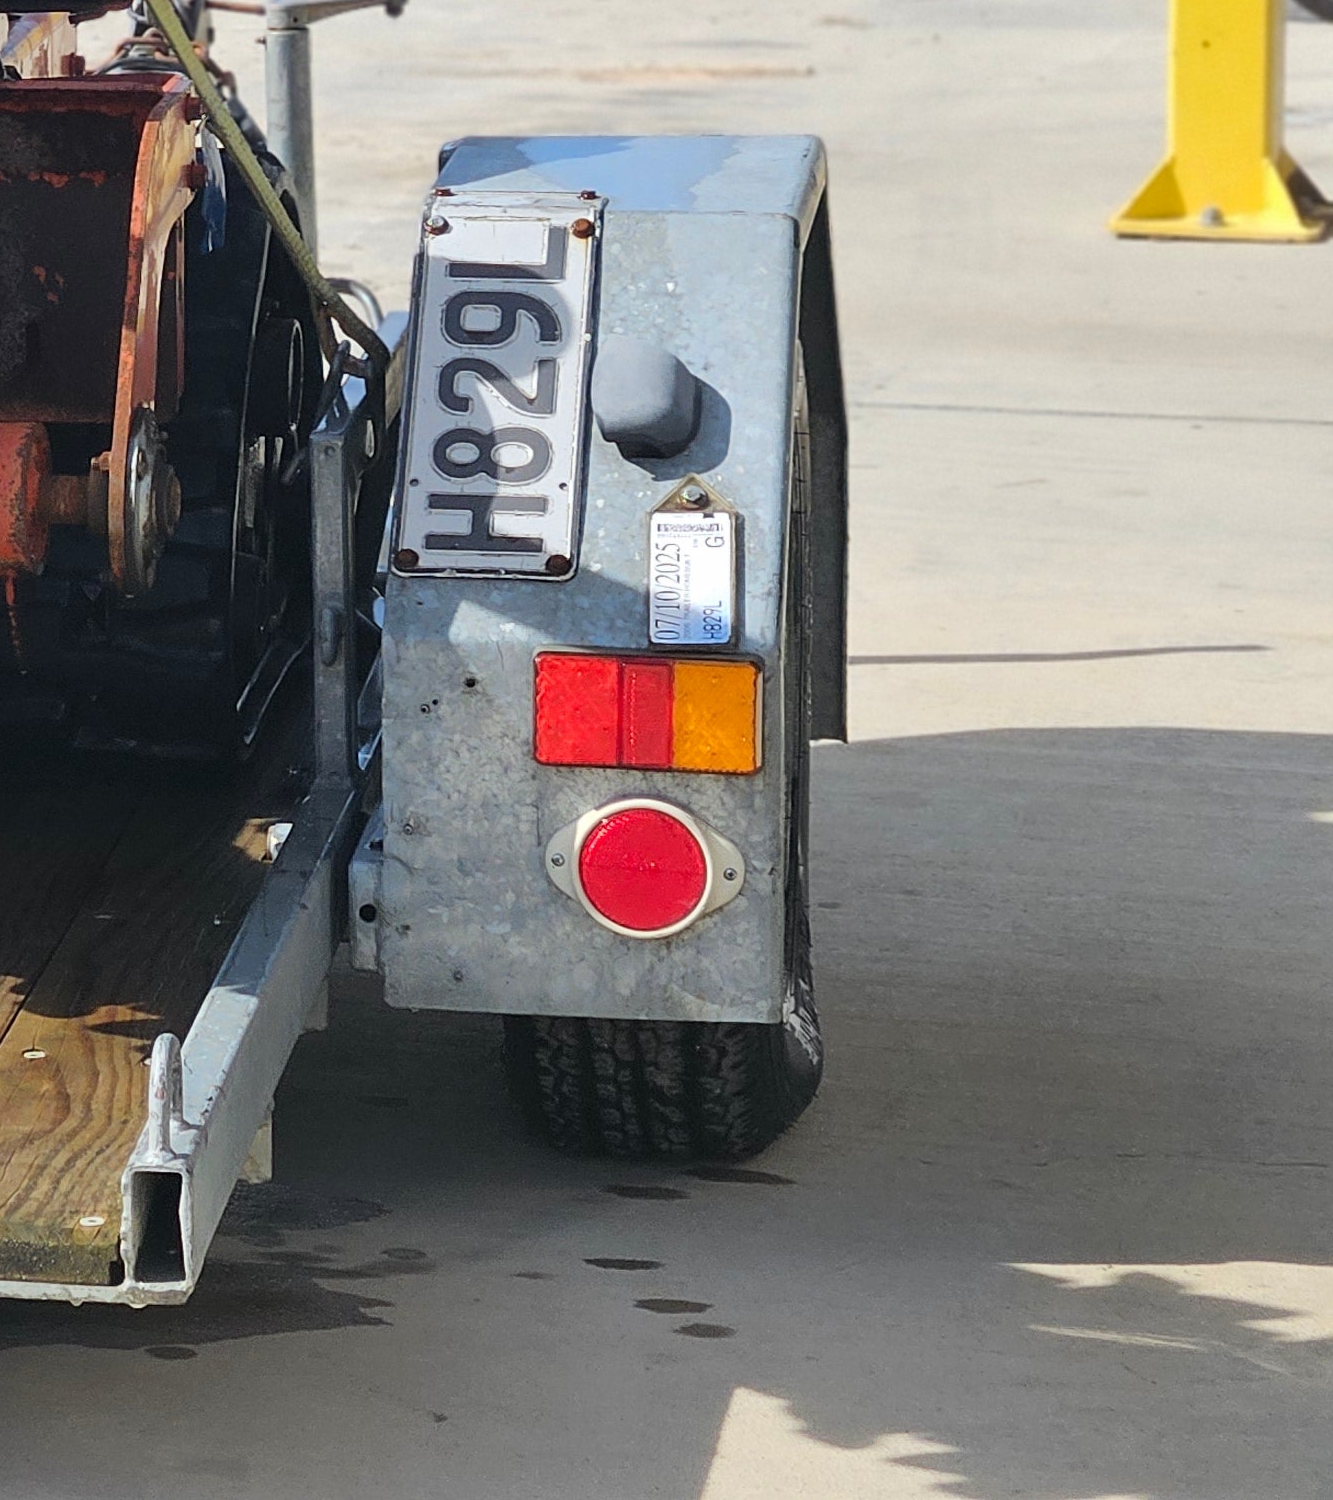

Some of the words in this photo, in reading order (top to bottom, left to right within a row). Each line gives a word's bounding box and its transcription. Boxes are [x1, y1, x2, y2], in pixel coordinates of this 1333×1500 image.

[425, 225, 568, 553] H829L
[654, 543, 682, 640] 07/10/2025
[703, 600, 723, 639] H829L
